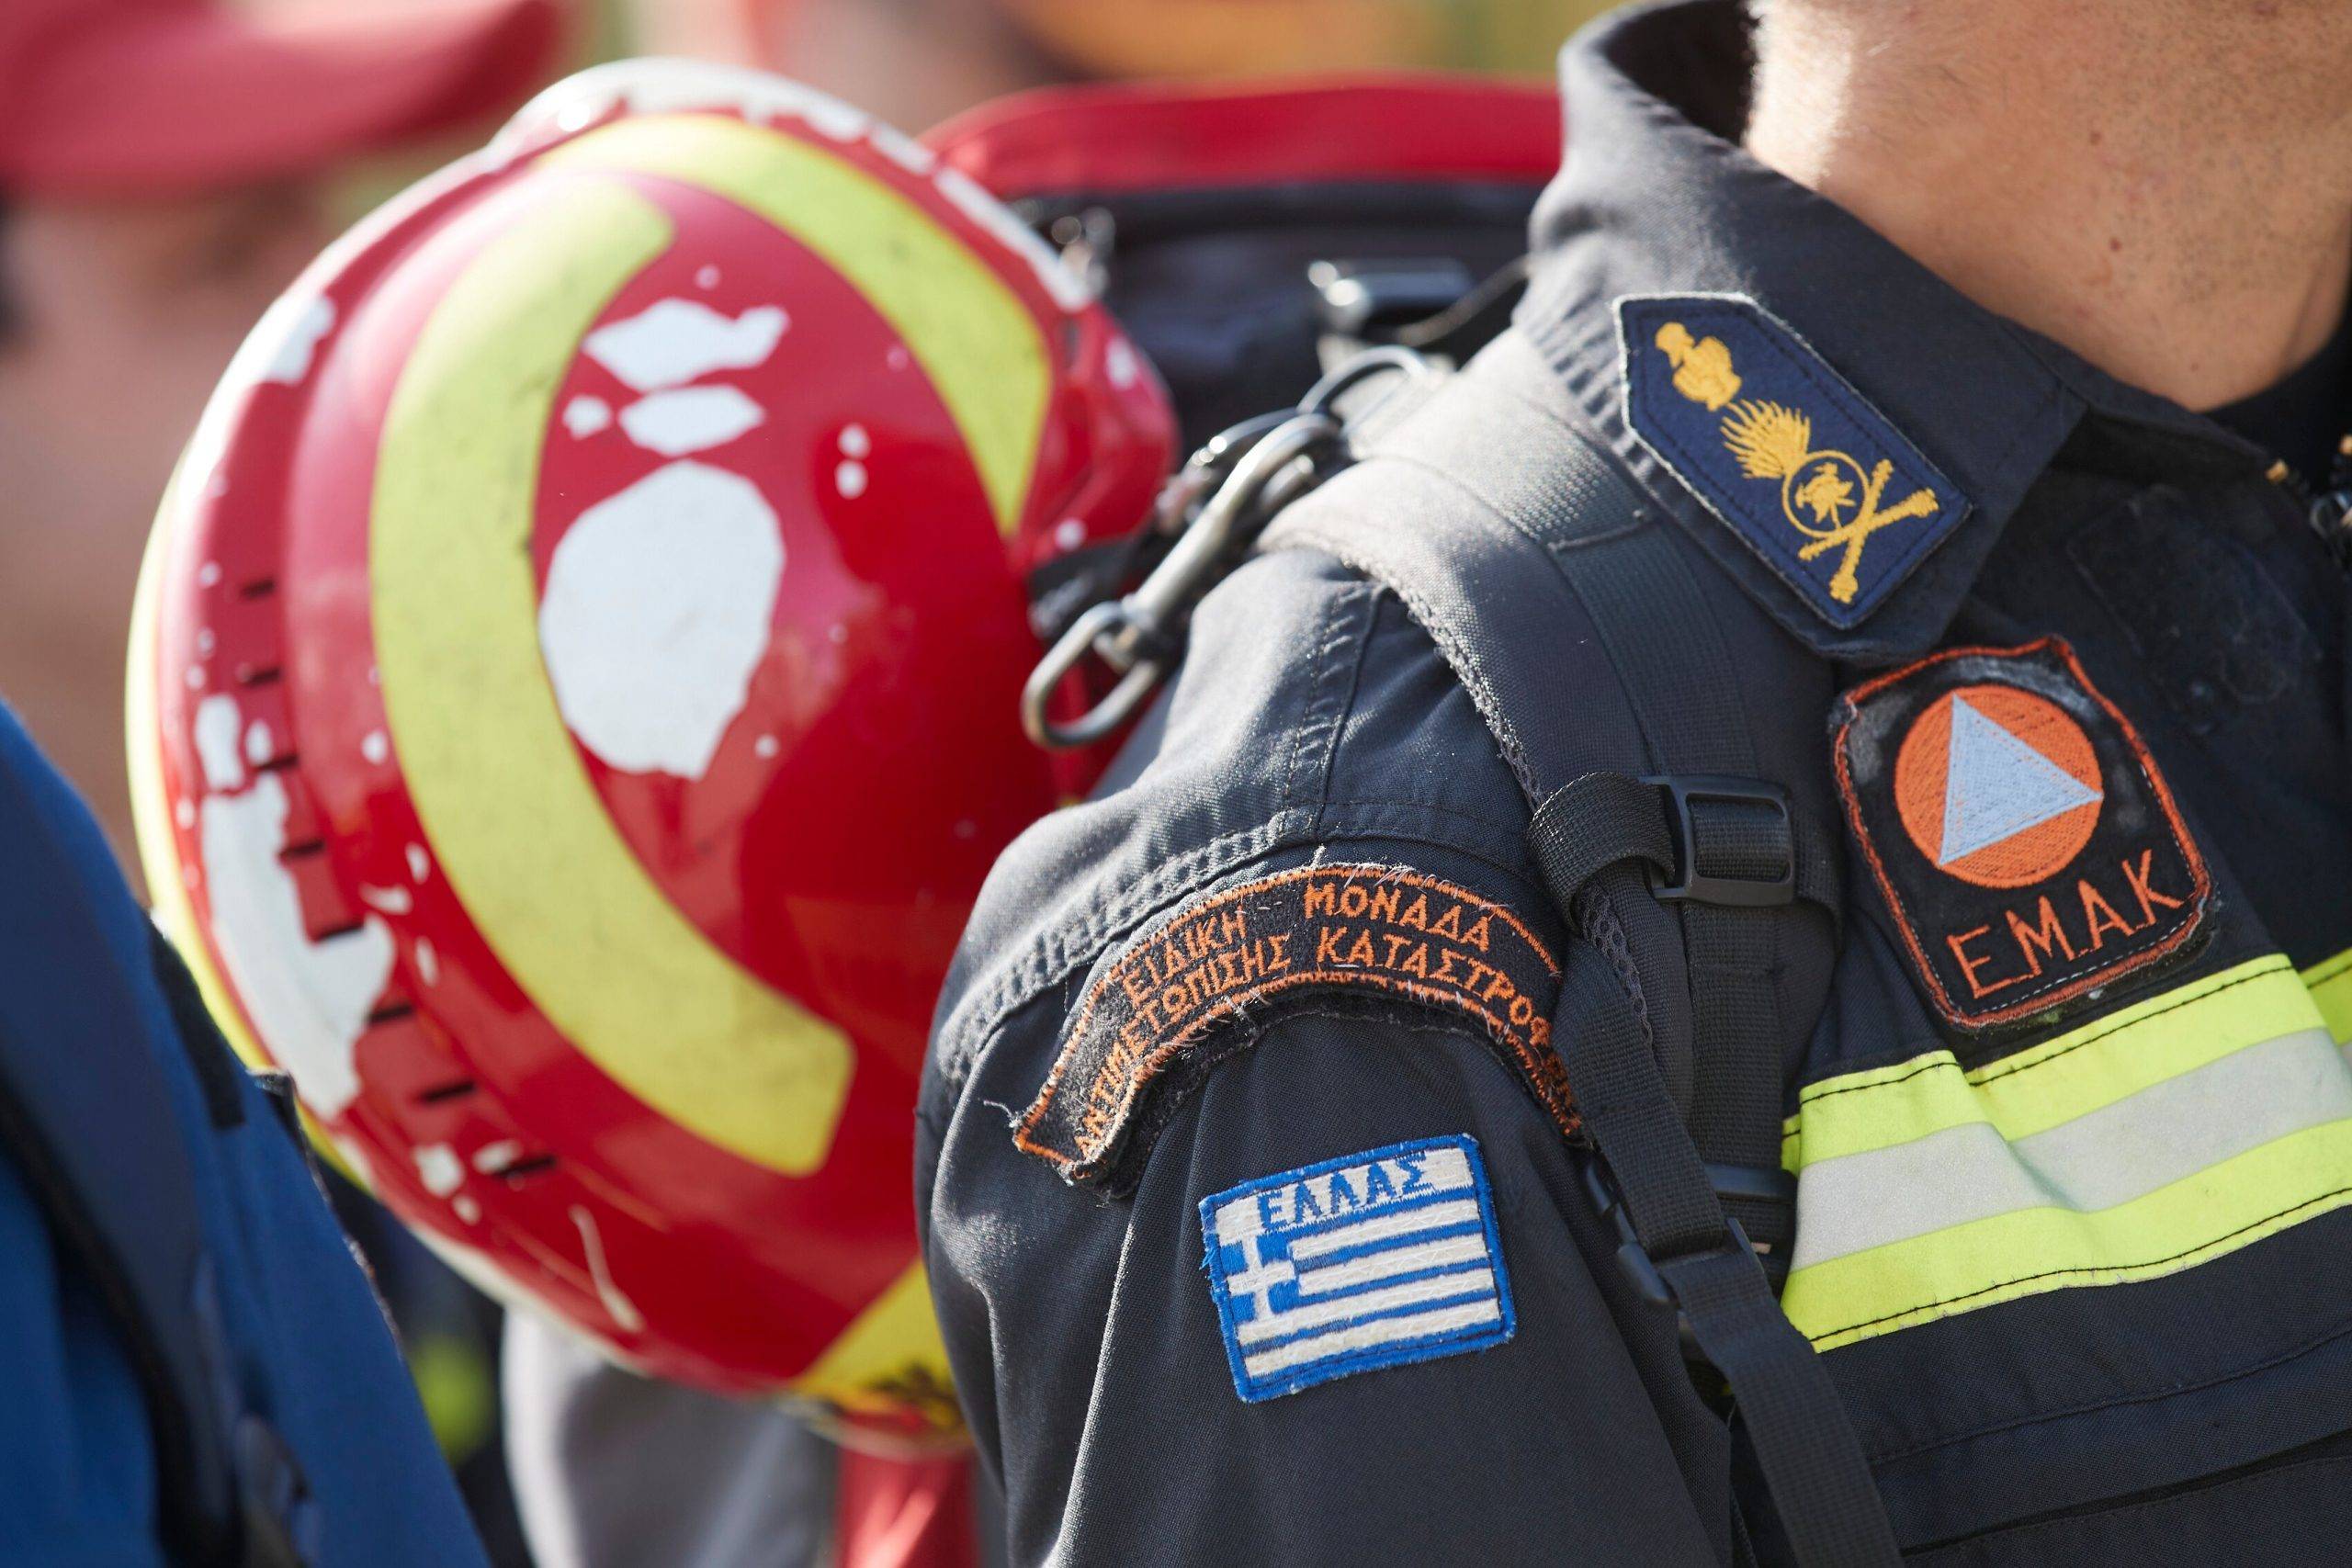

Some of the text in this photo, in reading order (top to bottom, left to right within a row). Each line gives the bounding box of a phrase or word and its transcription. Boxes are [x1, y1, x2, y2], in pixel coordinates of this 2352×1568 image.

[1122, 881, 1491, 1010] ΕΙΔΙΚΗ ΜΟΝΑΔΑ
[1946, 849, 2184, 999] ΕΜΑΚ
[1316, 925, 1574, 1109] ΚΑΤΑΣΤΡΟ
[1256, 1152, 1436, 1232] ΕΛΛΑΣ
